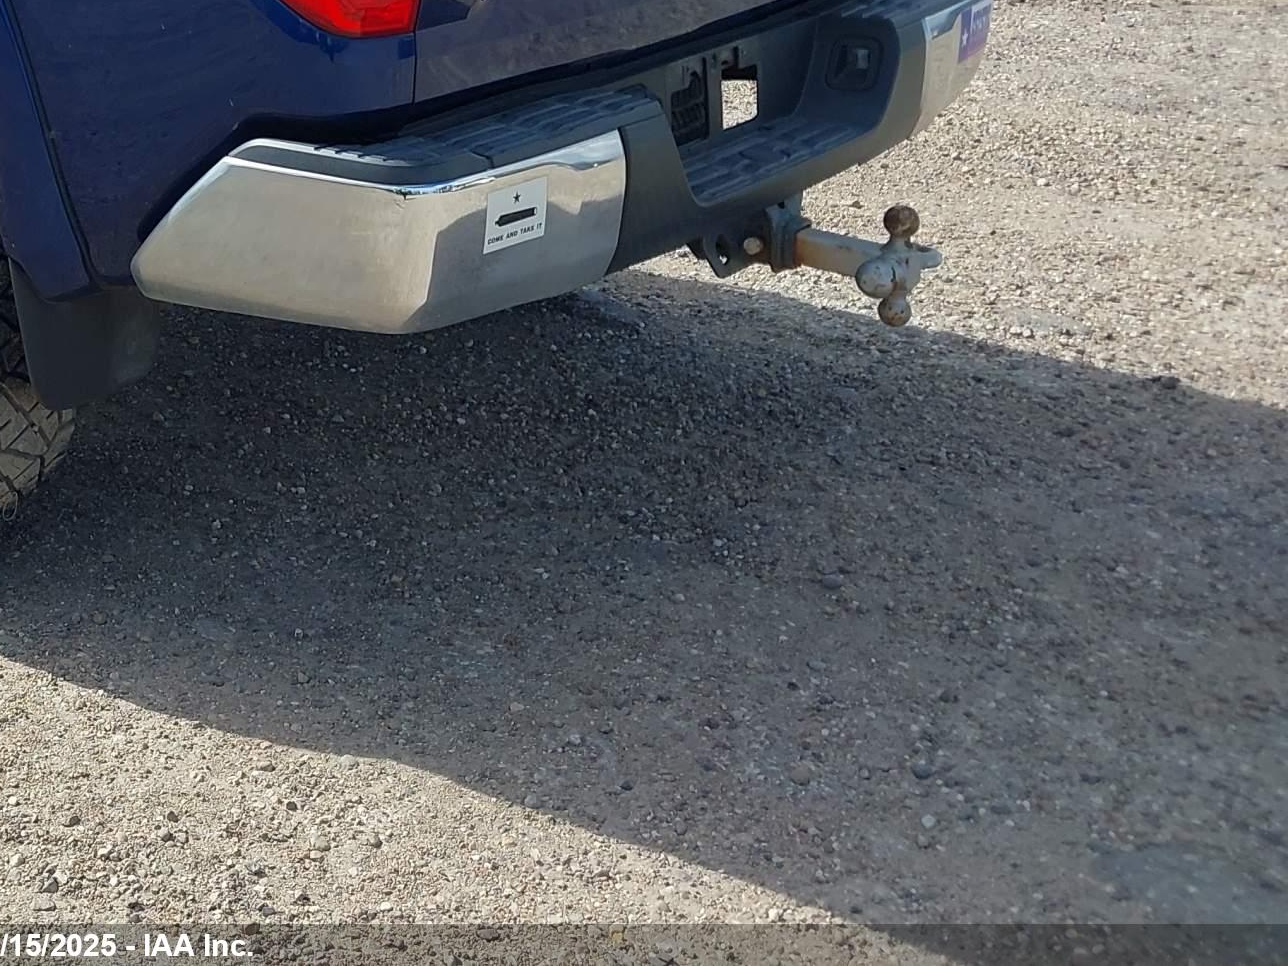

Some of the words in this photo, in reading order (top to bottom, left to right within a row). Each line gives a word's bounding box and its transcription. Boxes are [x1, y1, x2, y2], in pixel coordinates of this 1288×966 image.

[487, 236, 504, 246] COME
[506, 230, 518, 240] AND
[520, 226, 535, 235] TAKE
